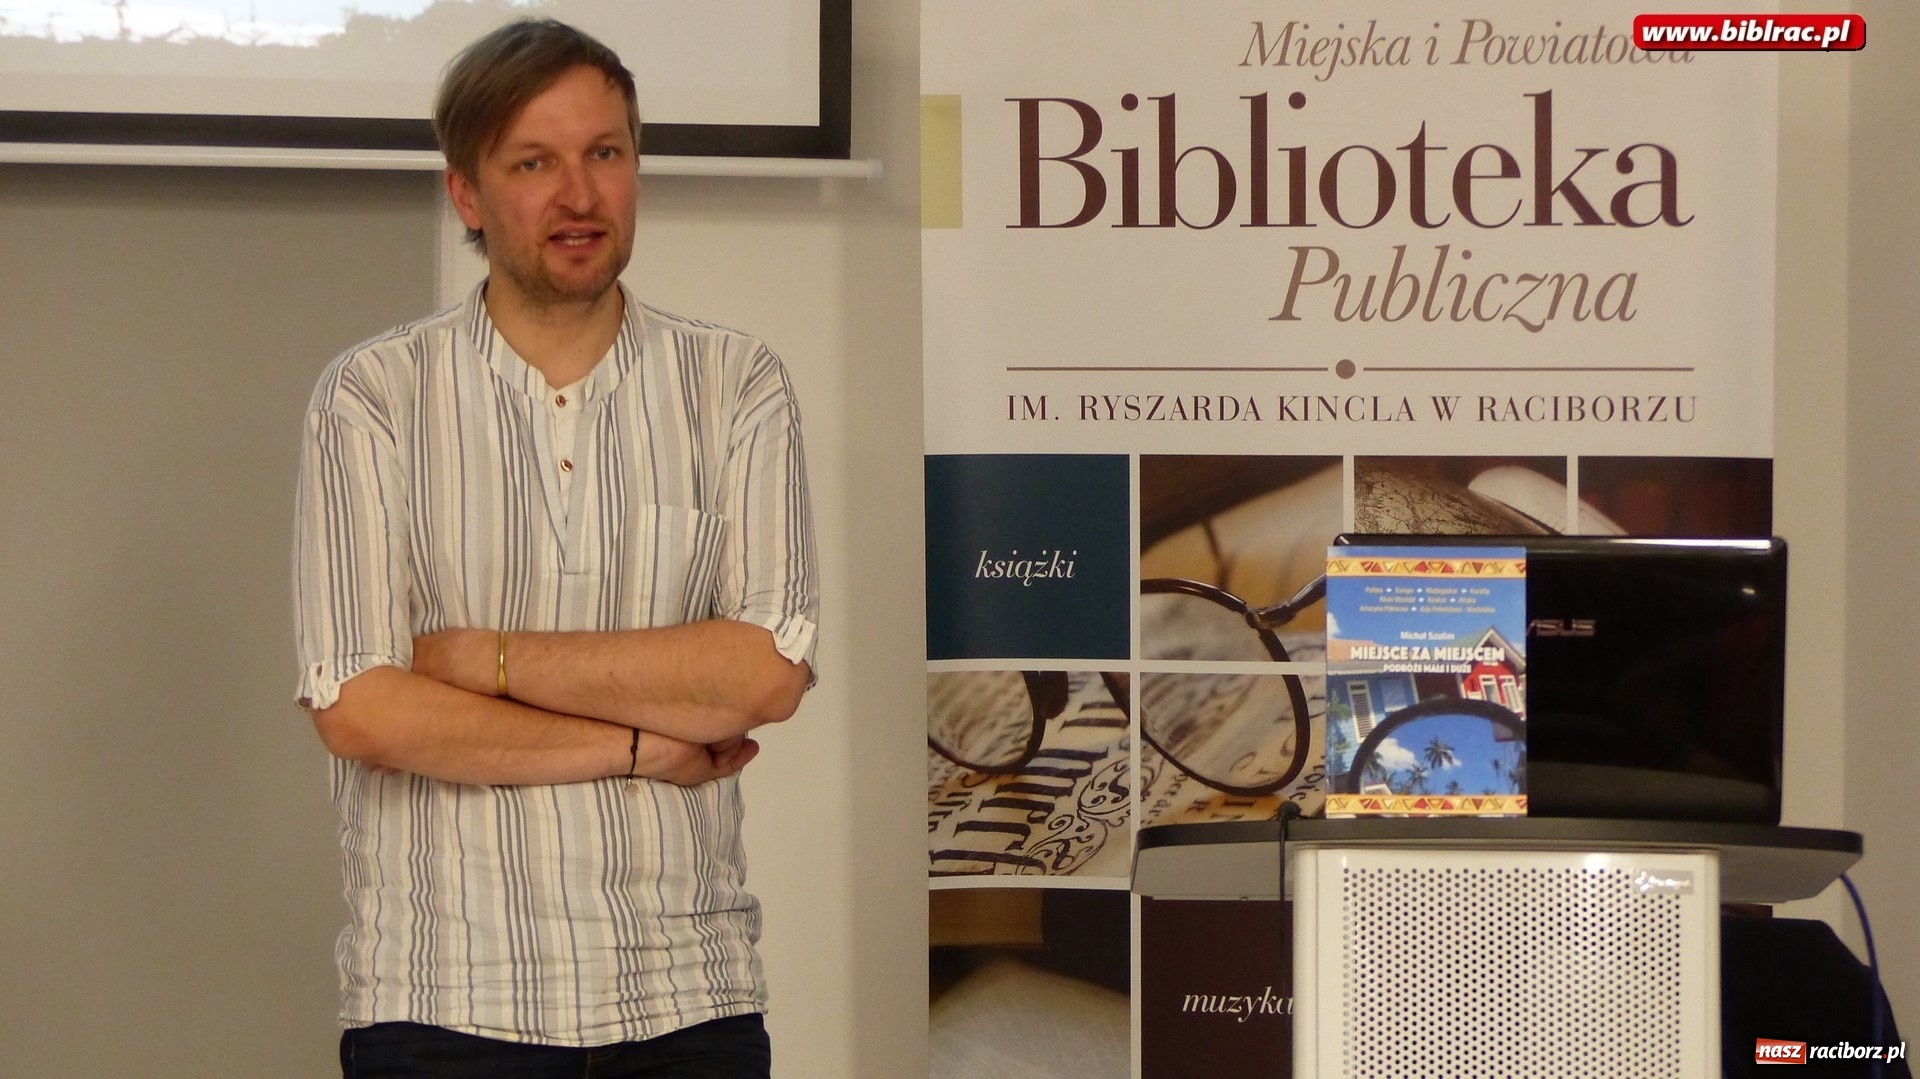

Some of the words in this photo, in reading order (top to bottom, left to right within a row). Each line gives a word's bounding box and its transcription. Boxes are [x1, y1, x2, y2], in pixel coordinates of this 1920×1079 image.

[1238, 20, 1411, 81] Miejska
[1425, 22, 1440, 66] i
[1005, 90, 1695, 230] Biblioteka
[1268, 244, 1638, 334] Publiczna
[1007, 394, 1060, 421] IM.
[1079, 394, 1263, 422] RYSZARDA
[1277, 395, 1417, 422] KINCLA
[1430, 395, 1461, 422] W
[1477, 395, 1697, 423] RACIBORZU
[975, 549, 1077, 587] książki
[1351, 646, 1409, 660] MIEJSCE
[1411, 646, 1431, 661] ZA
[1434, 647, 1505, 662] MIEJSCEM
[1182, 985, 1293, 1023] muzyka
